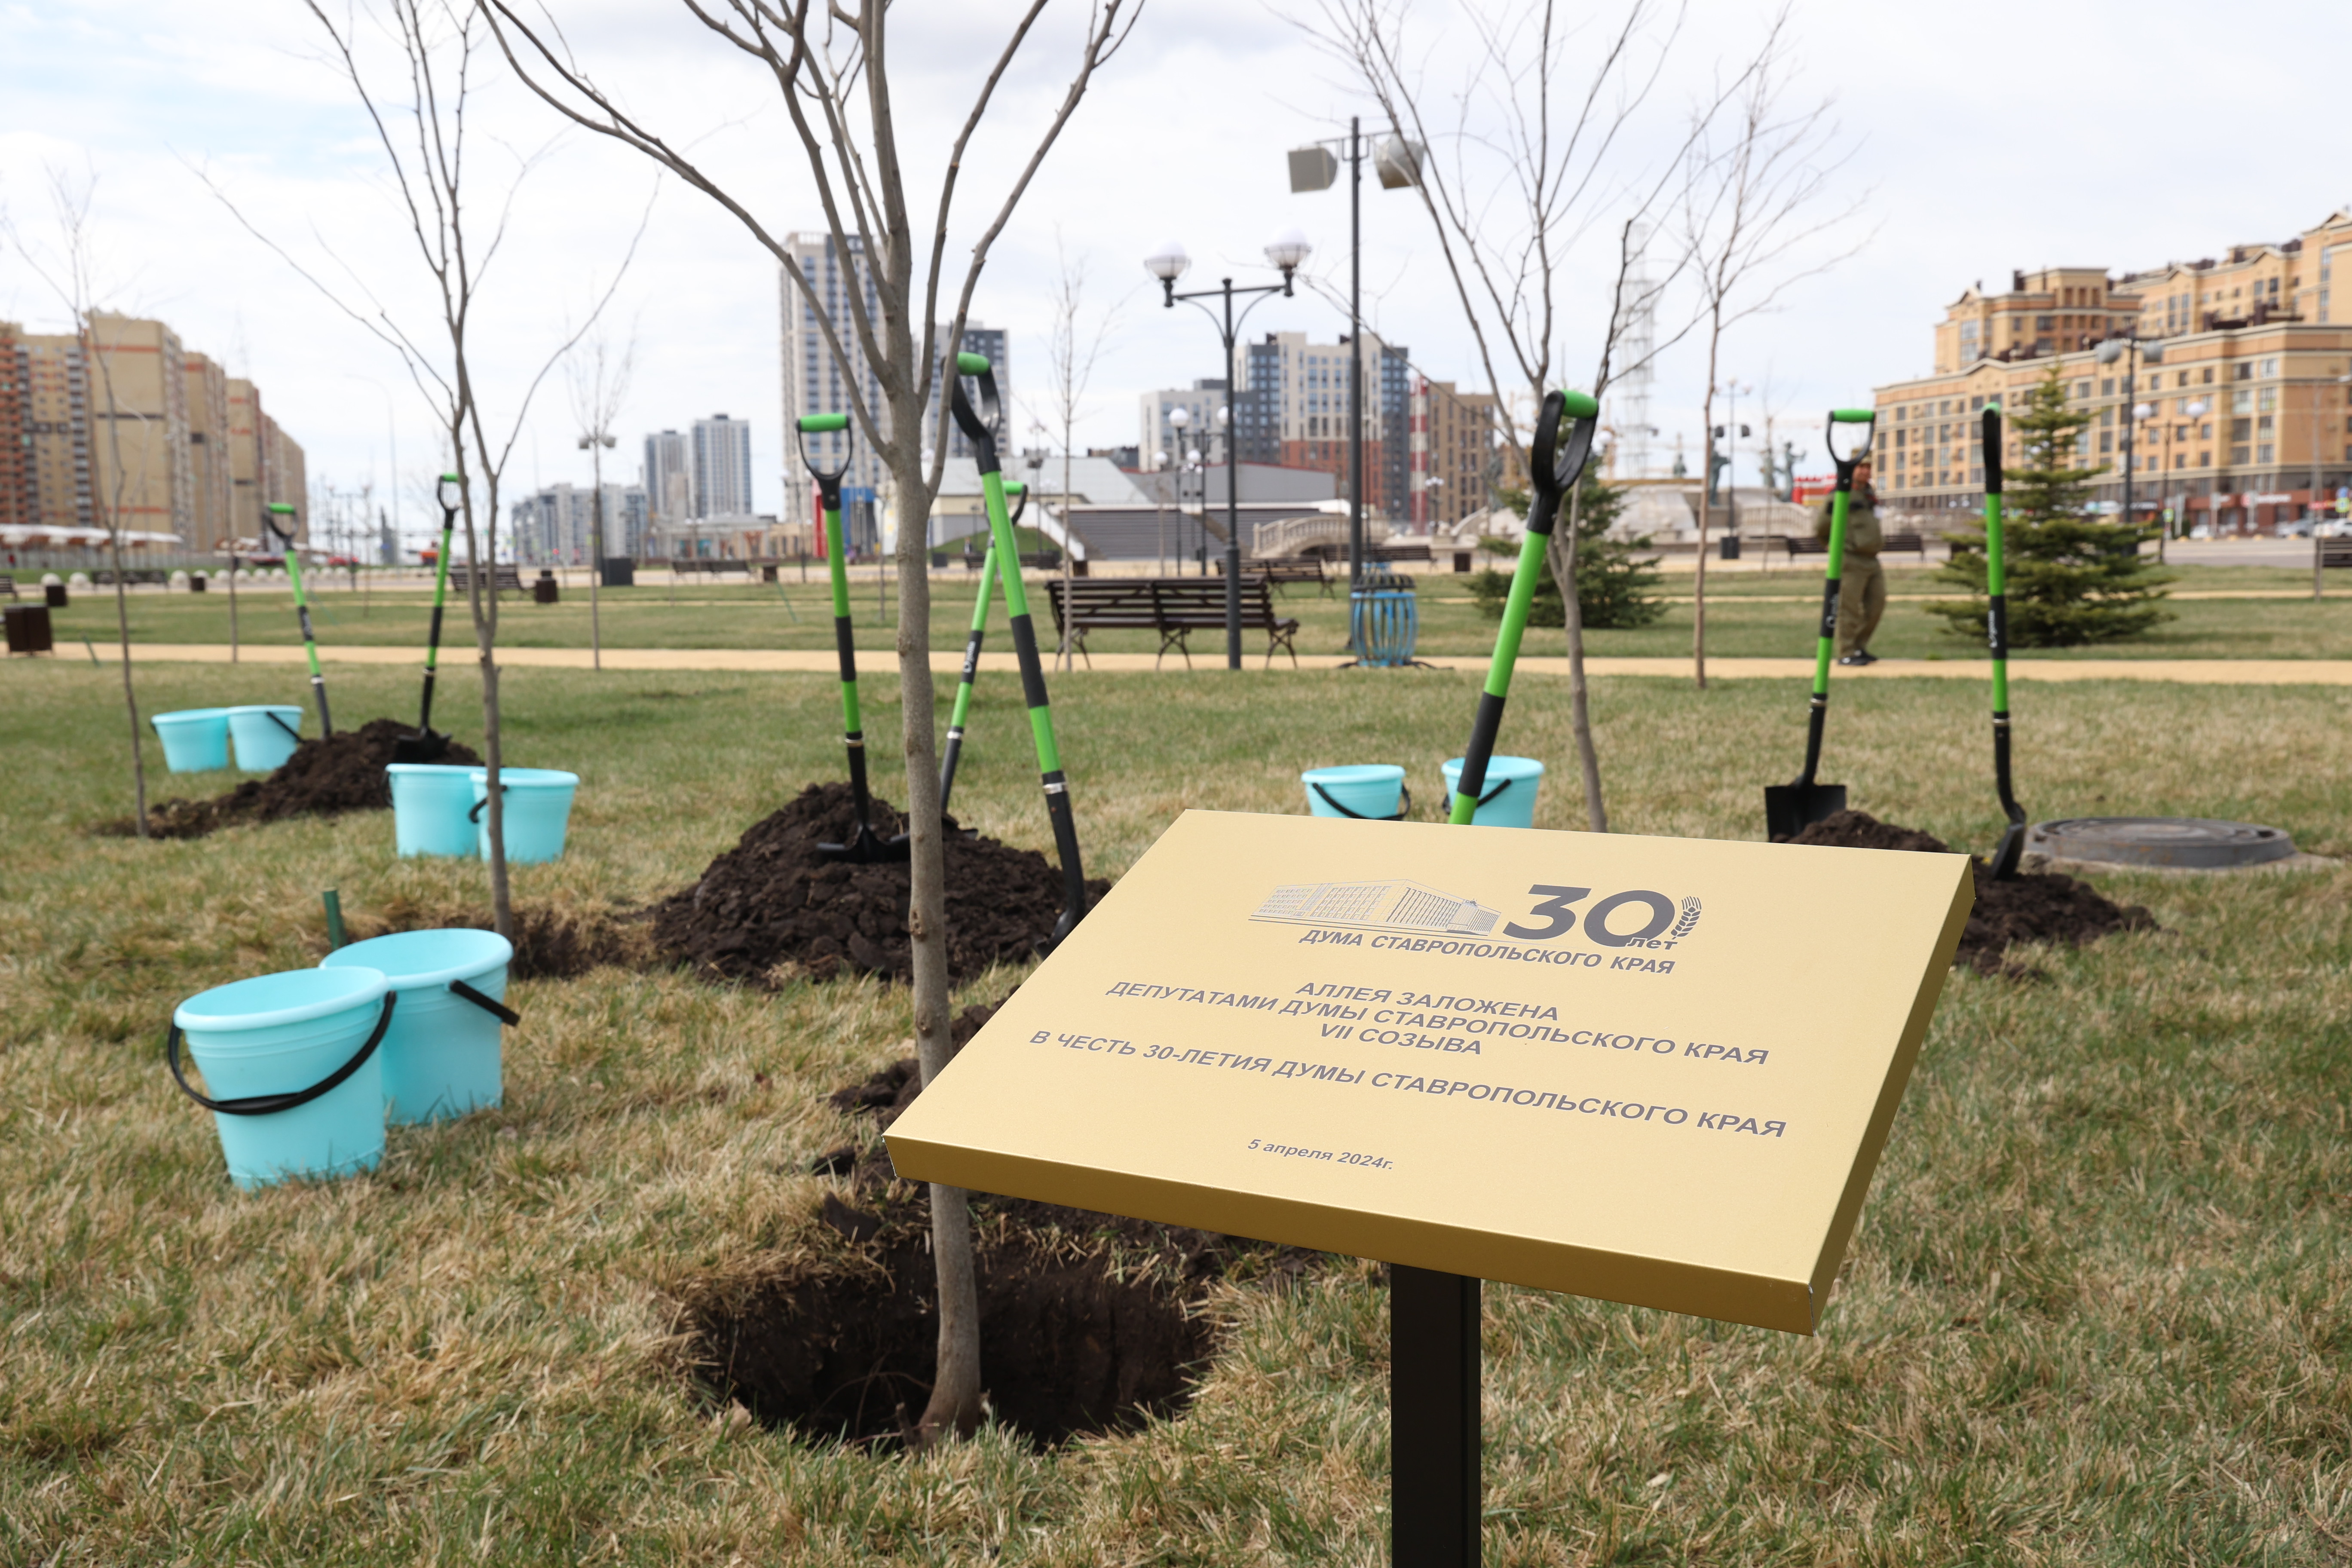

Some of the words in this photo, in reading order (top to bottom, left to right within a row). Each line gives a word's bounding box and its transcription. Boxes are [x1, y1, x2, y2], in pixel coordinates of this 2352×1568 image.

[1502, 884, 1675, 947] 30
[1299, 930, 1363, 946] ДУМА
[1371, 935, 1602, 967] СТАВРОПОЛЬСКОГО
[1610, 956, 1676, 974] КРАЯ
[1627, 938, 1678, 950] лет
[1295, 982, 1393, 1003] АЛЛЕЯ
[1396, 992, 1557, 1021] ЗАЛОЖЕНА
[1105, 982, 1279, 1011] ДЕПУТАТАМИ
[1277, 1000, 1369, 1020] ДУМЫ
[1374, 1010, 1675, 1054] СТАВРОПОЛЬСКОГО
[1684, 1042, 1769, 1065] КРАЯ
[1321, 1023, 1354, 1039] VII
[1359, 1029, 1480, 1055] СОЗЫВА
[1029, 1031, 1051, 1044] В
[1058, 1033, 1136, 1055] ЧЕСТЬ
[1143, 1044, 1273, 1072] 30-ЛЕТИЯ
[1271, 1061, 1366, 1084] ДУМЫ
[1372, 1072, 1688, 1124] СТАВРОПОЛЬСКОГО
[1697, 1112, 1787, 1137] КРАЯ
[1248, 1139, 1262, 1149] 5
[1263, 1144, 1333, 1161] апреля
[1336, 1152, 1393, 1169] 2024г.
